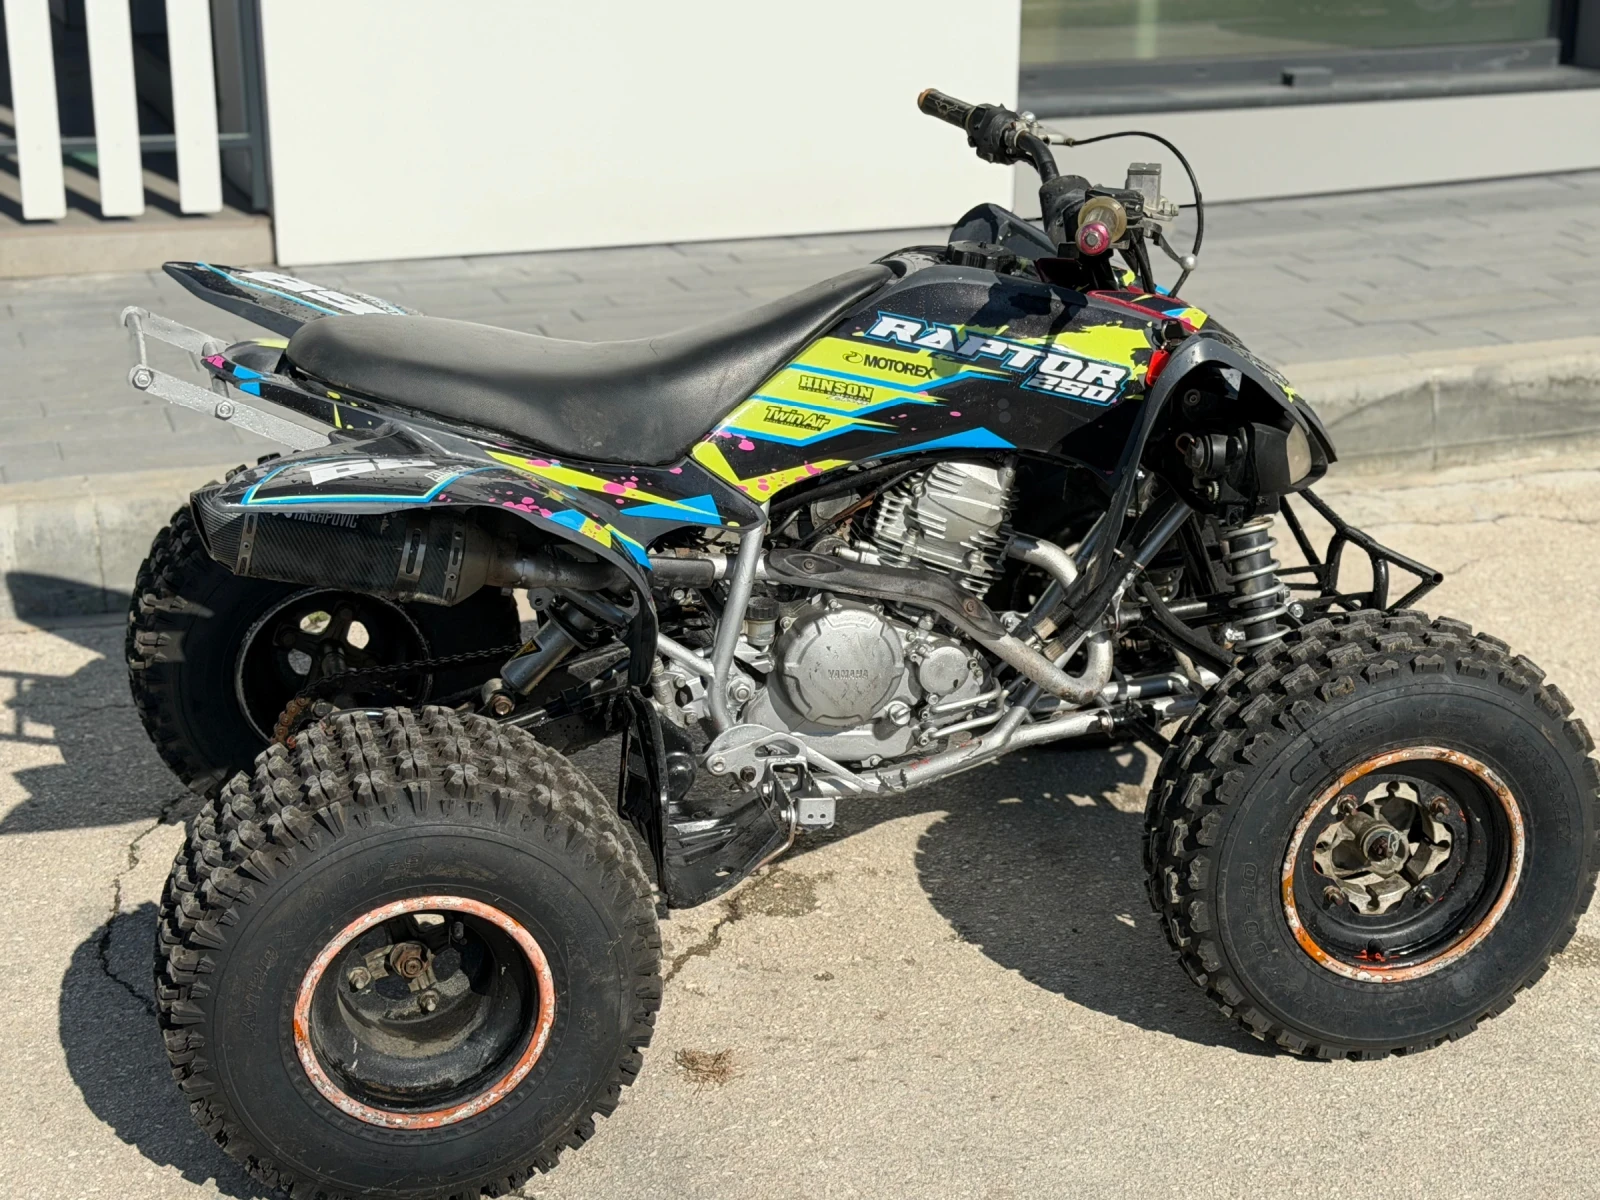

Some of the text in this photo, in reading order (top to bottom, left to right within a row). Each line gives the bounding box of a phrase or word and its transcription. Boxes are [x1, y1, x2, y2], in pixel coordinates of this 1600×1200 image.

[868, 315, 1127, 389] RAPTOR
[863, 354, 937, 379] MOTOREX
[799, 375, 874, 400] HINSON
[764, 406, 804, 424] Twin
[803, 412, 831, 431] Air
[828, 669, 868, 680] YAMAHA
